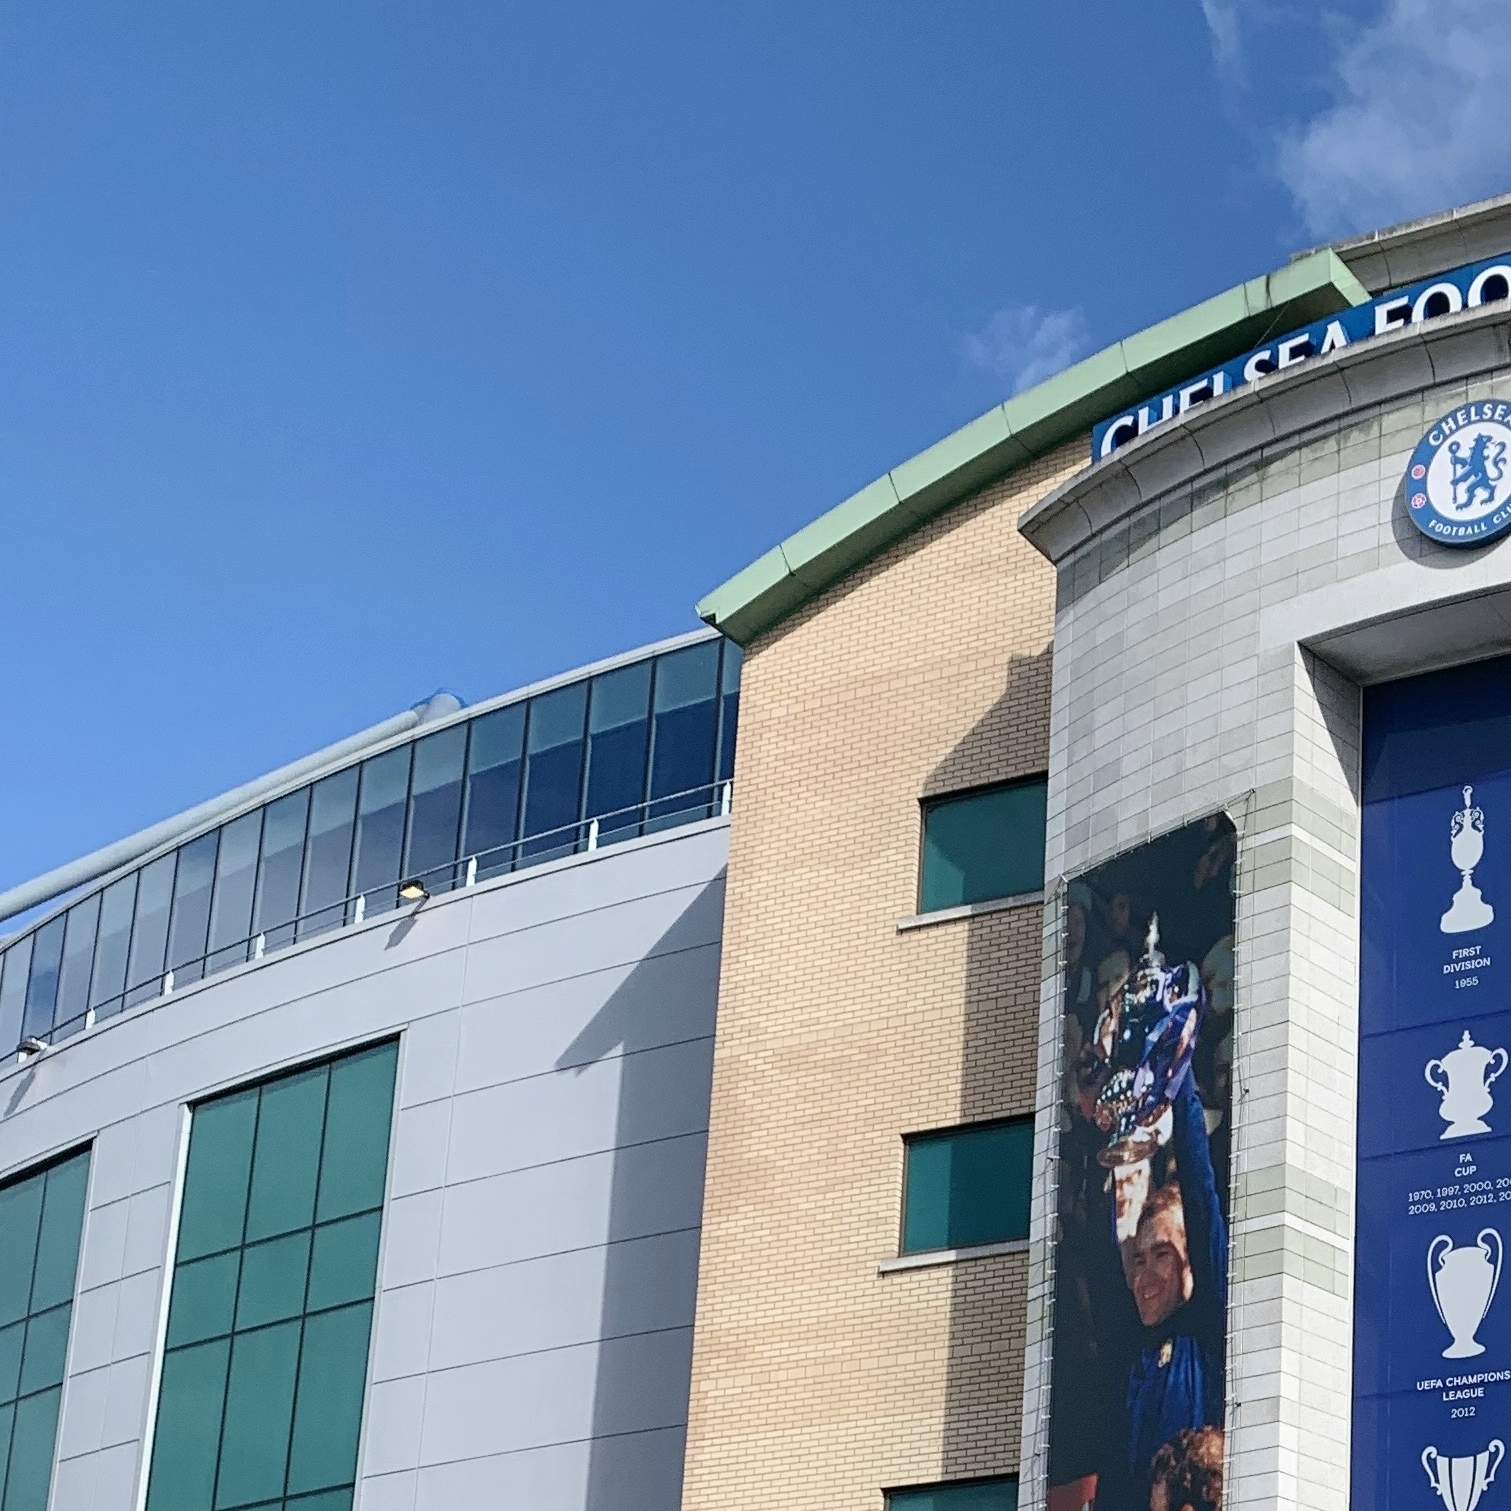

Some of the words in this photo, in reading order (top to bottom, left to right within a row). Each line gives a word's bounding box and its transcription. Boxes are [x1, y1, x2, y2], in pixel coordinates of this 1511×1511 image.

[1428, 520, 1487, 536] FOOTBALL
[1452, 945, 1482, 959] FIRST
[1443, 957, 1491, 974] DIVISION
[1454, 976, 1479, 989] 1955
[1459, 1153, 1472, 1165] FA
[1454, 1165, 1477, 1177] CUP
[1408, 1189, 1434, 1202] 1970,
[1464, 1180, 1493, 1194] 2000,
[1408, 1201, 1437, 1215] 2009,
[1440, 1197, 1467, 1210] 2010,
[1417, 1378, 1444, 1391] UEFA
[1445, 1370, 1511, 1387] CHAMPIONS
[1442, 1387, 1485, 1401] LEAGUE
[1451, 1407, 1476, 1419] 2012
